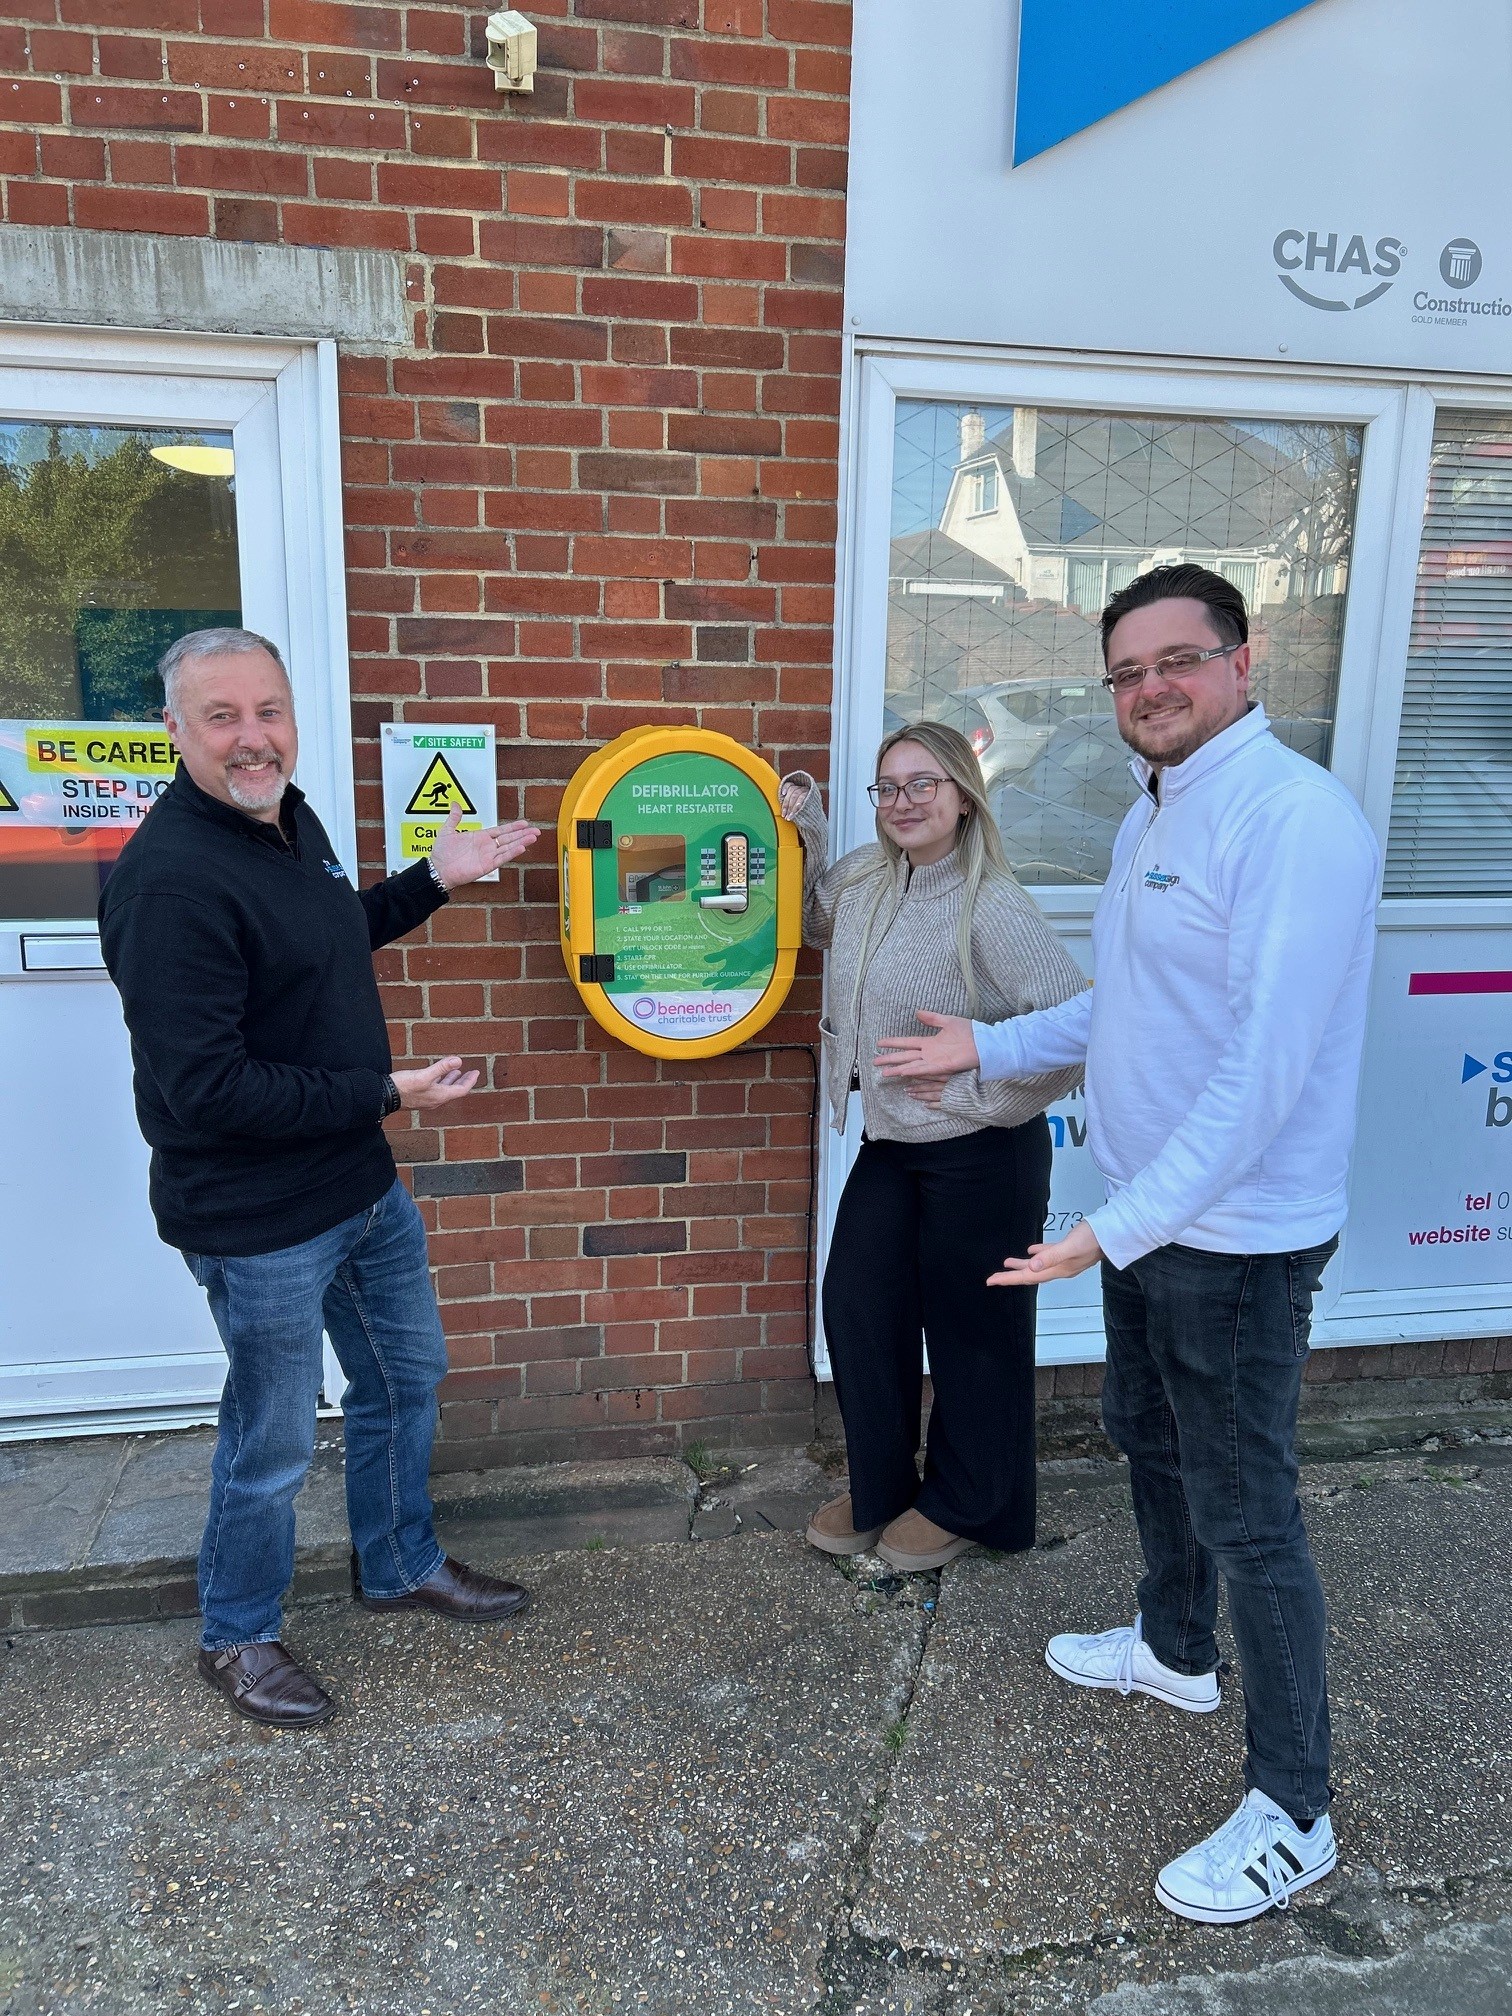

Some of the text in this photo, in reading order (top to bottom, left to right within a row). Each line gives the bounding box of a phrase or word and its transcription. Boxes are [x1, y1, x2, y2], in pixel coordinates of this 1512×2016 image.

[1411, 315, 1468, 327] GOLD MEMBER
[427, 736, 484, 748] SITE SAFETY
[37, 740, 78, 763] BE
[62, 779, 127, 799] STEP
[632, 784, 739, 798] DEFIBRILLATOR
[63, 804, 154, 818] INSIDE TH
[638, 803, 734, 814] HEART RESTARTER
[411, 844, 433, 853] Mind
[663, 943, 682, 951] CODE
[663, 972, 678, 980] LINE
[692, 971, 719, 979] FURTHER
[720, 970, 751, 978] GUIDANCE
[658, 1000, 733, 1016] benenden
[657, 1013, 733, 1025] charitable trust
[1465, 1192, 1492, 1211] tel
[1408, 1224, 1491, 1246] website
